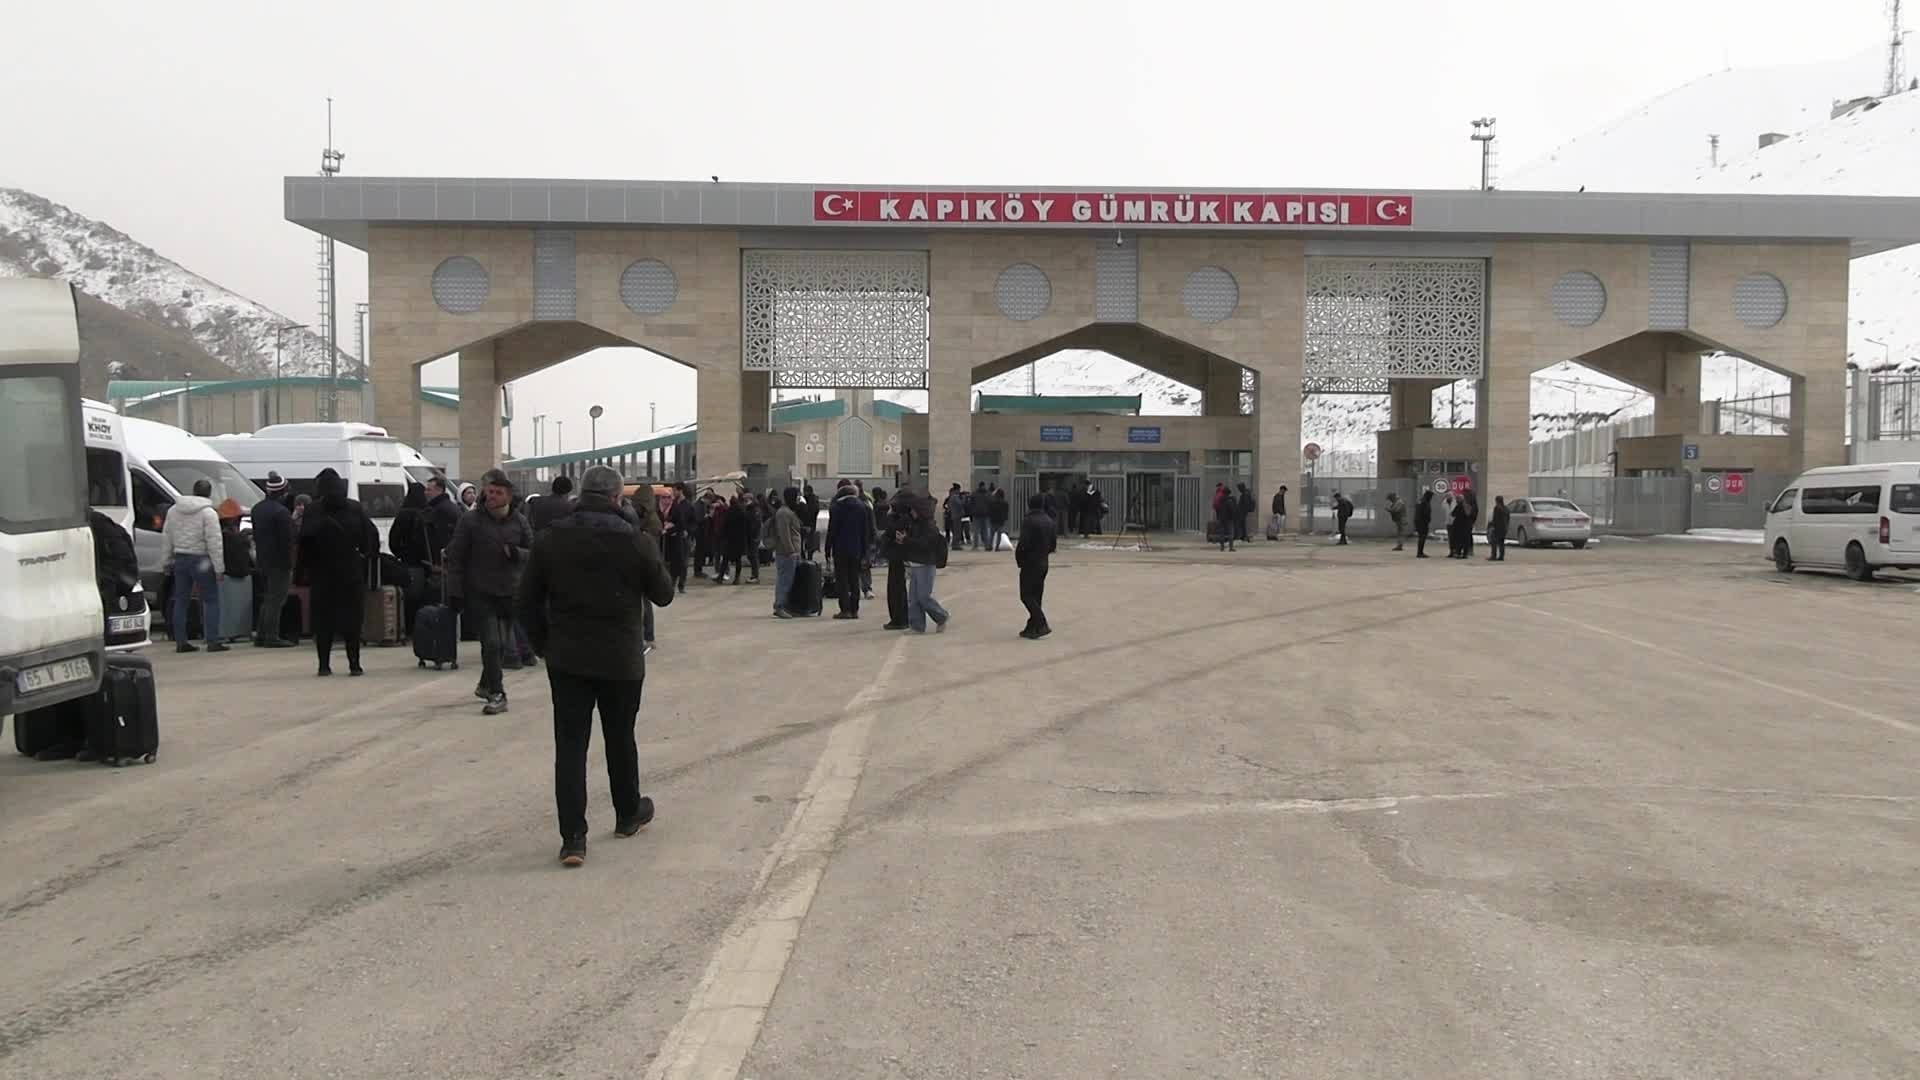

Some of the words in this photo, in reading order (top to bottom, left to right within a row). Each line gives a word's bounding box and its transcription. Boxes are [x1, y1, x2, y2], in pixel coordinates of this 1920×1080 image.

[880, 193, 1055, 222] KAPIKÖY
[1072, 194, 1221, 223] GÜMRÜK
[1233, 201, 1350, 225] KAPISI
[88, 423, 112, 435] KHOY
[1452, 480, 1471, 490] DUR
[1725, 479, 1743, 488] DUR
[18, 552, 67, 567] TRANSIT
[26, 671, 42, 689] 65
[47, 668, 56, 683] V
